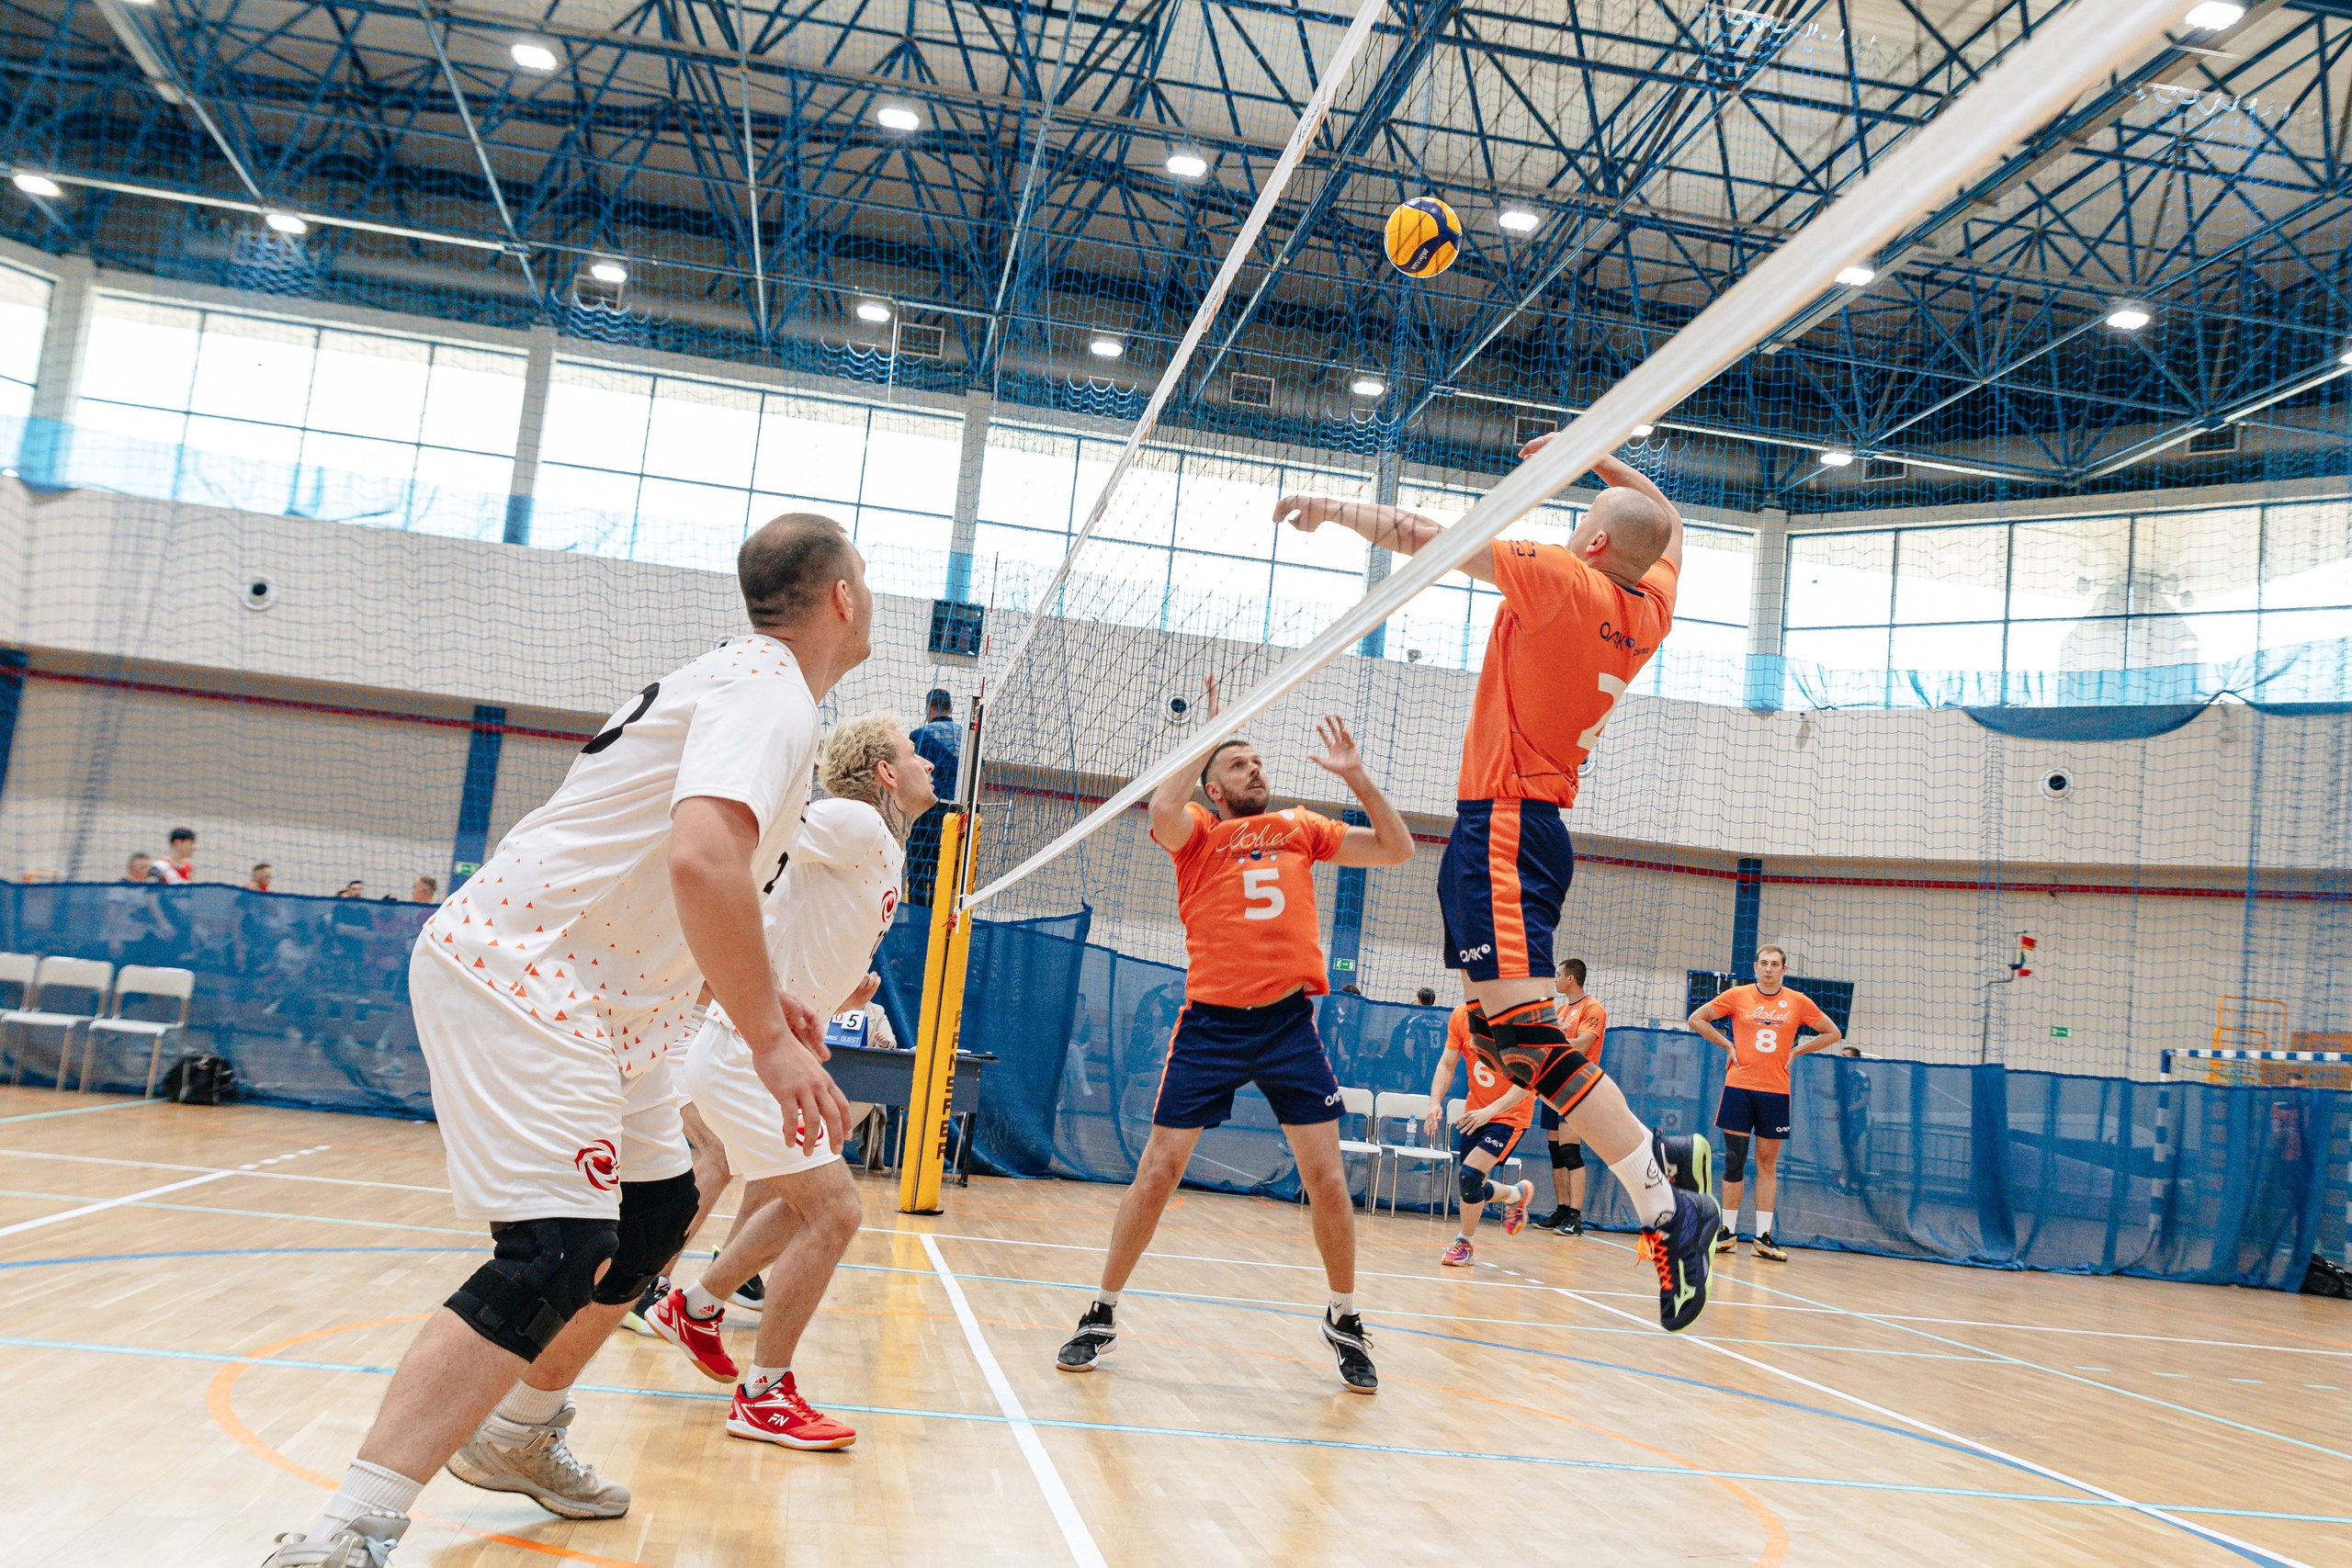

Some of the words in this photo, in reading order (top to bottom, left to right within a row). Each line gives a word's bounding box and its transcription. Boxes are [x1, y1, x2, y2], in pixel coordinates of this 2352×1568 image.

[1242, 867, 1285, 920] 5
[846, 1014, 859, 1028] 5
[840, 1035, 860, 1043] GUEST
[1755, 1029, 1777, 1053] 8
[1473, 1060, 1496, 1088] 6
[767, 1412, 789, 1427] FN
